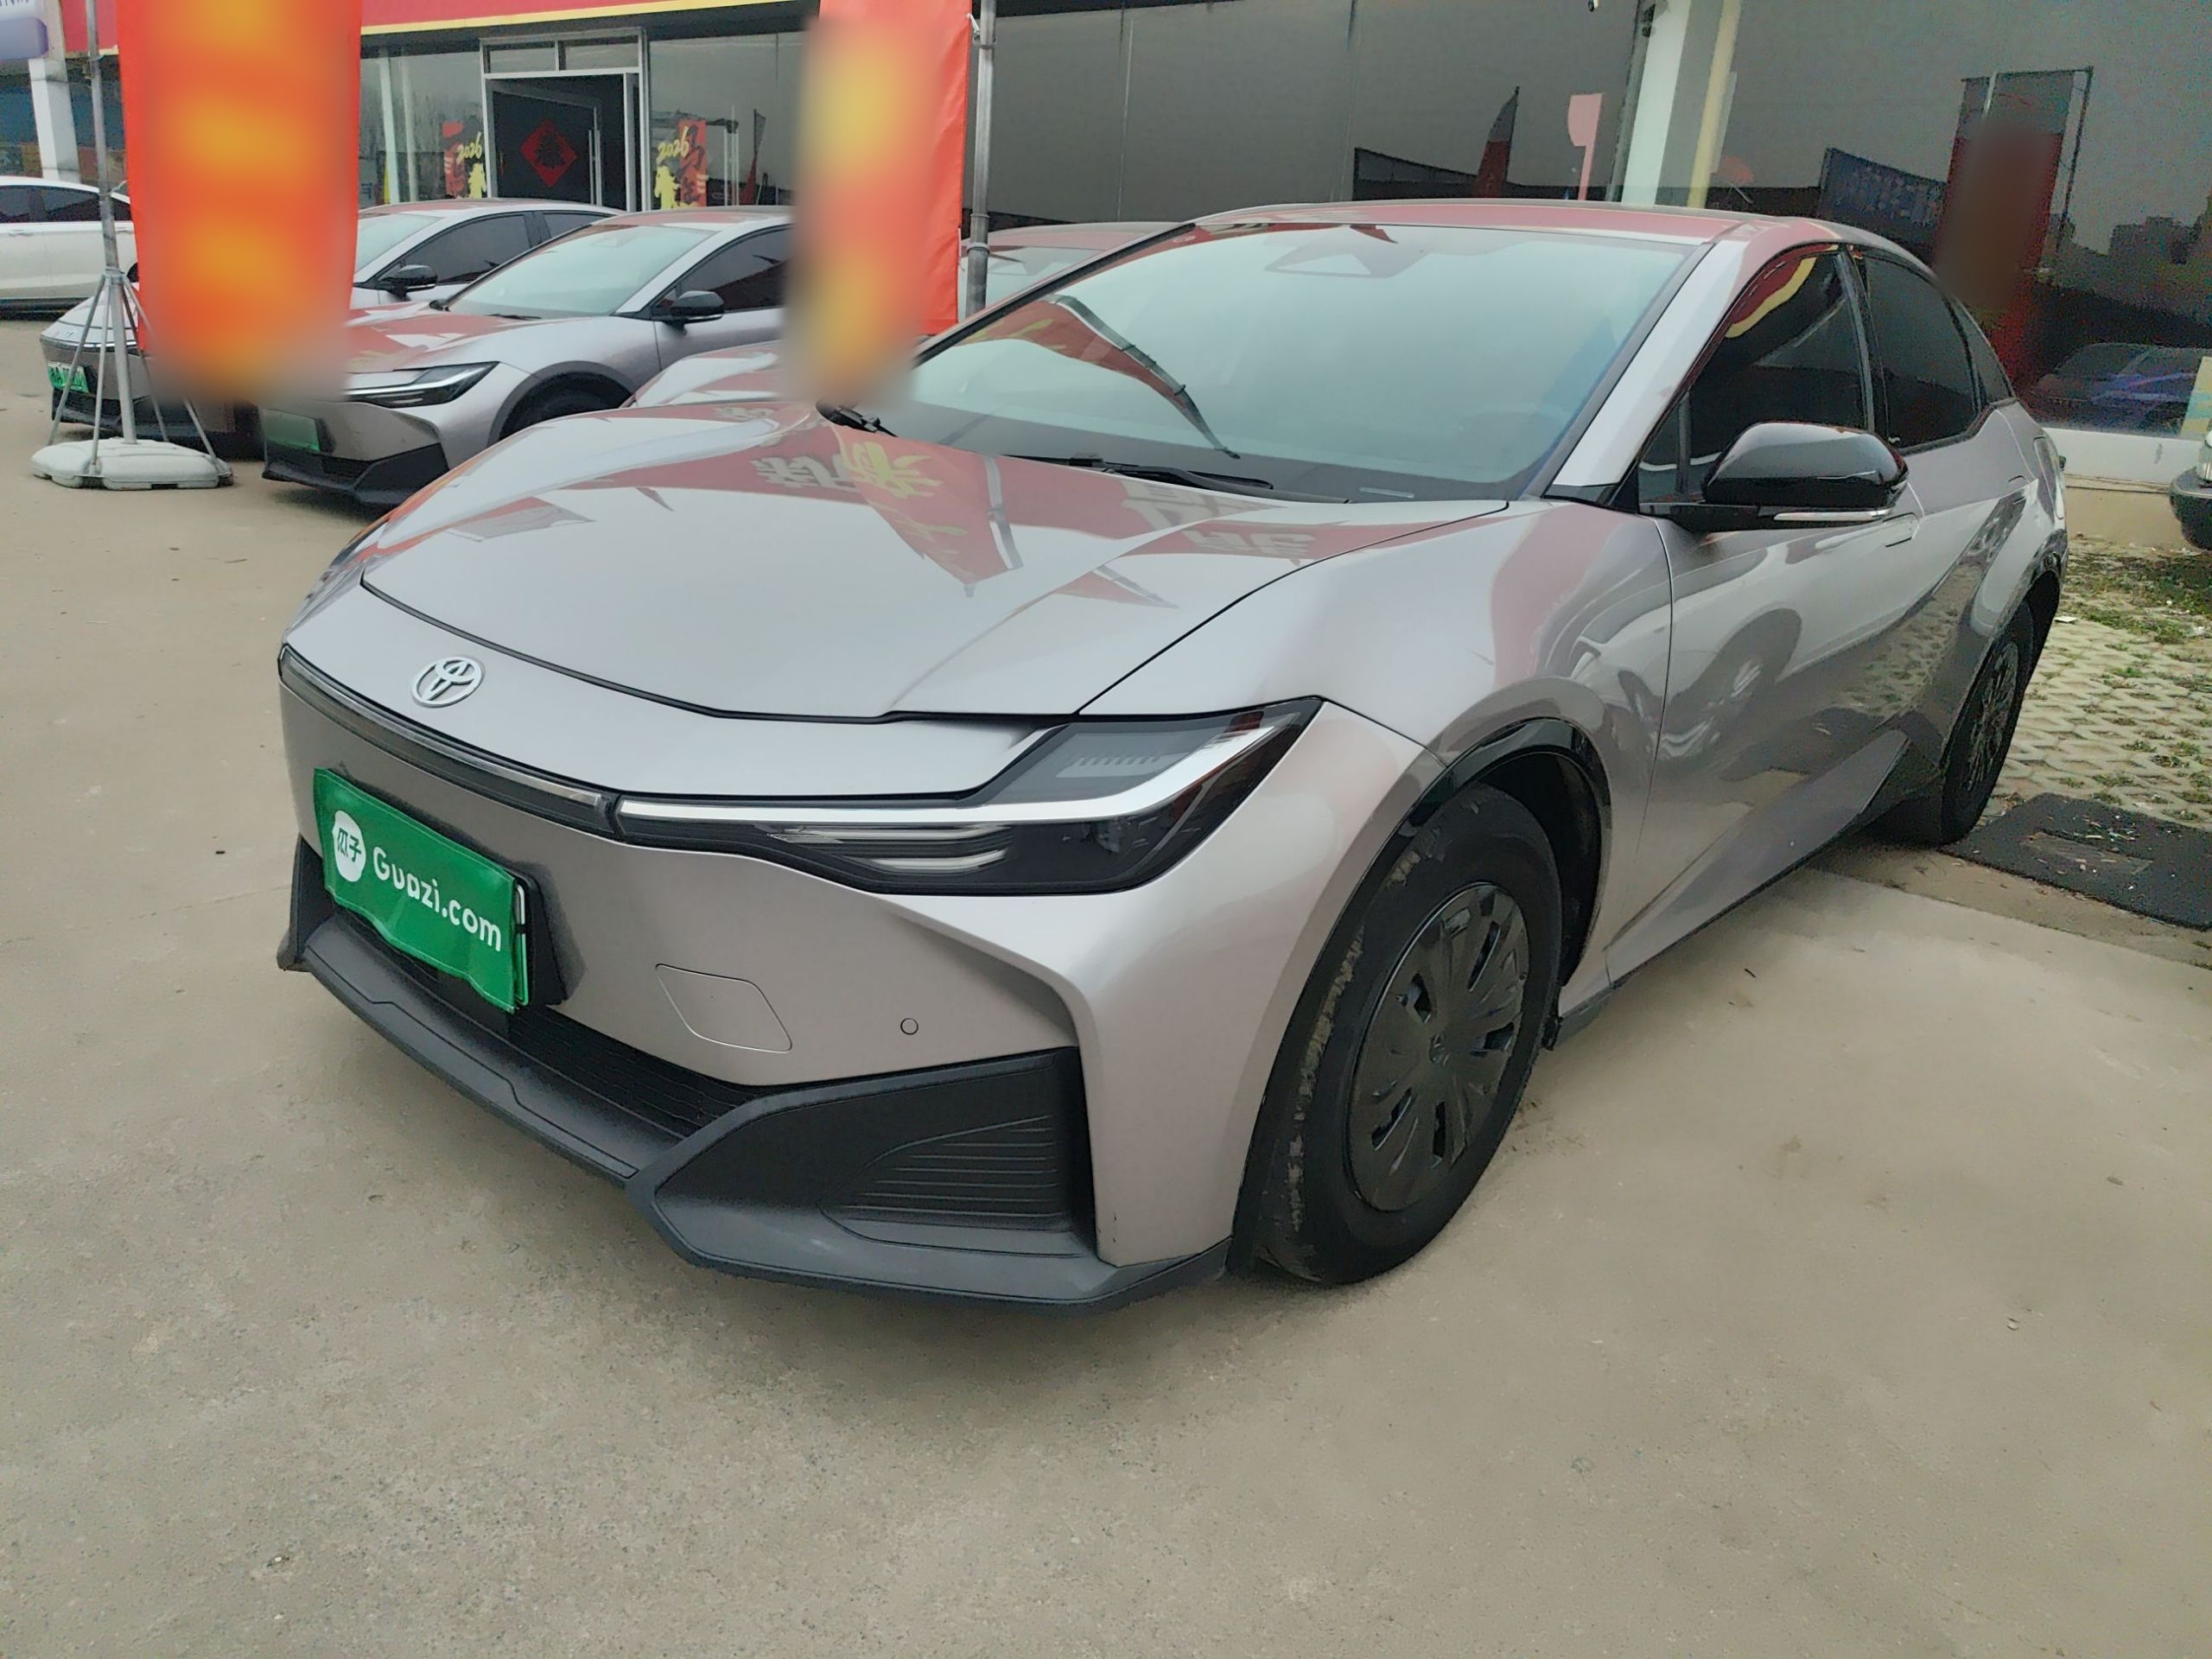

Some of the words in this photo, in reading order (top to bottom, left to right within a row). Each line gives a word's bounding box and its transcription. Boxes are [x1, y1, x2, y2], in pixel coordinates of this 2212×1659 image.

[456, 130, 483, 165] 2026
[656, 126, 690, 165] 2026
[336, 827, 363, 863] 瓜子
[372, 846, 502, 952] Guazi.com
